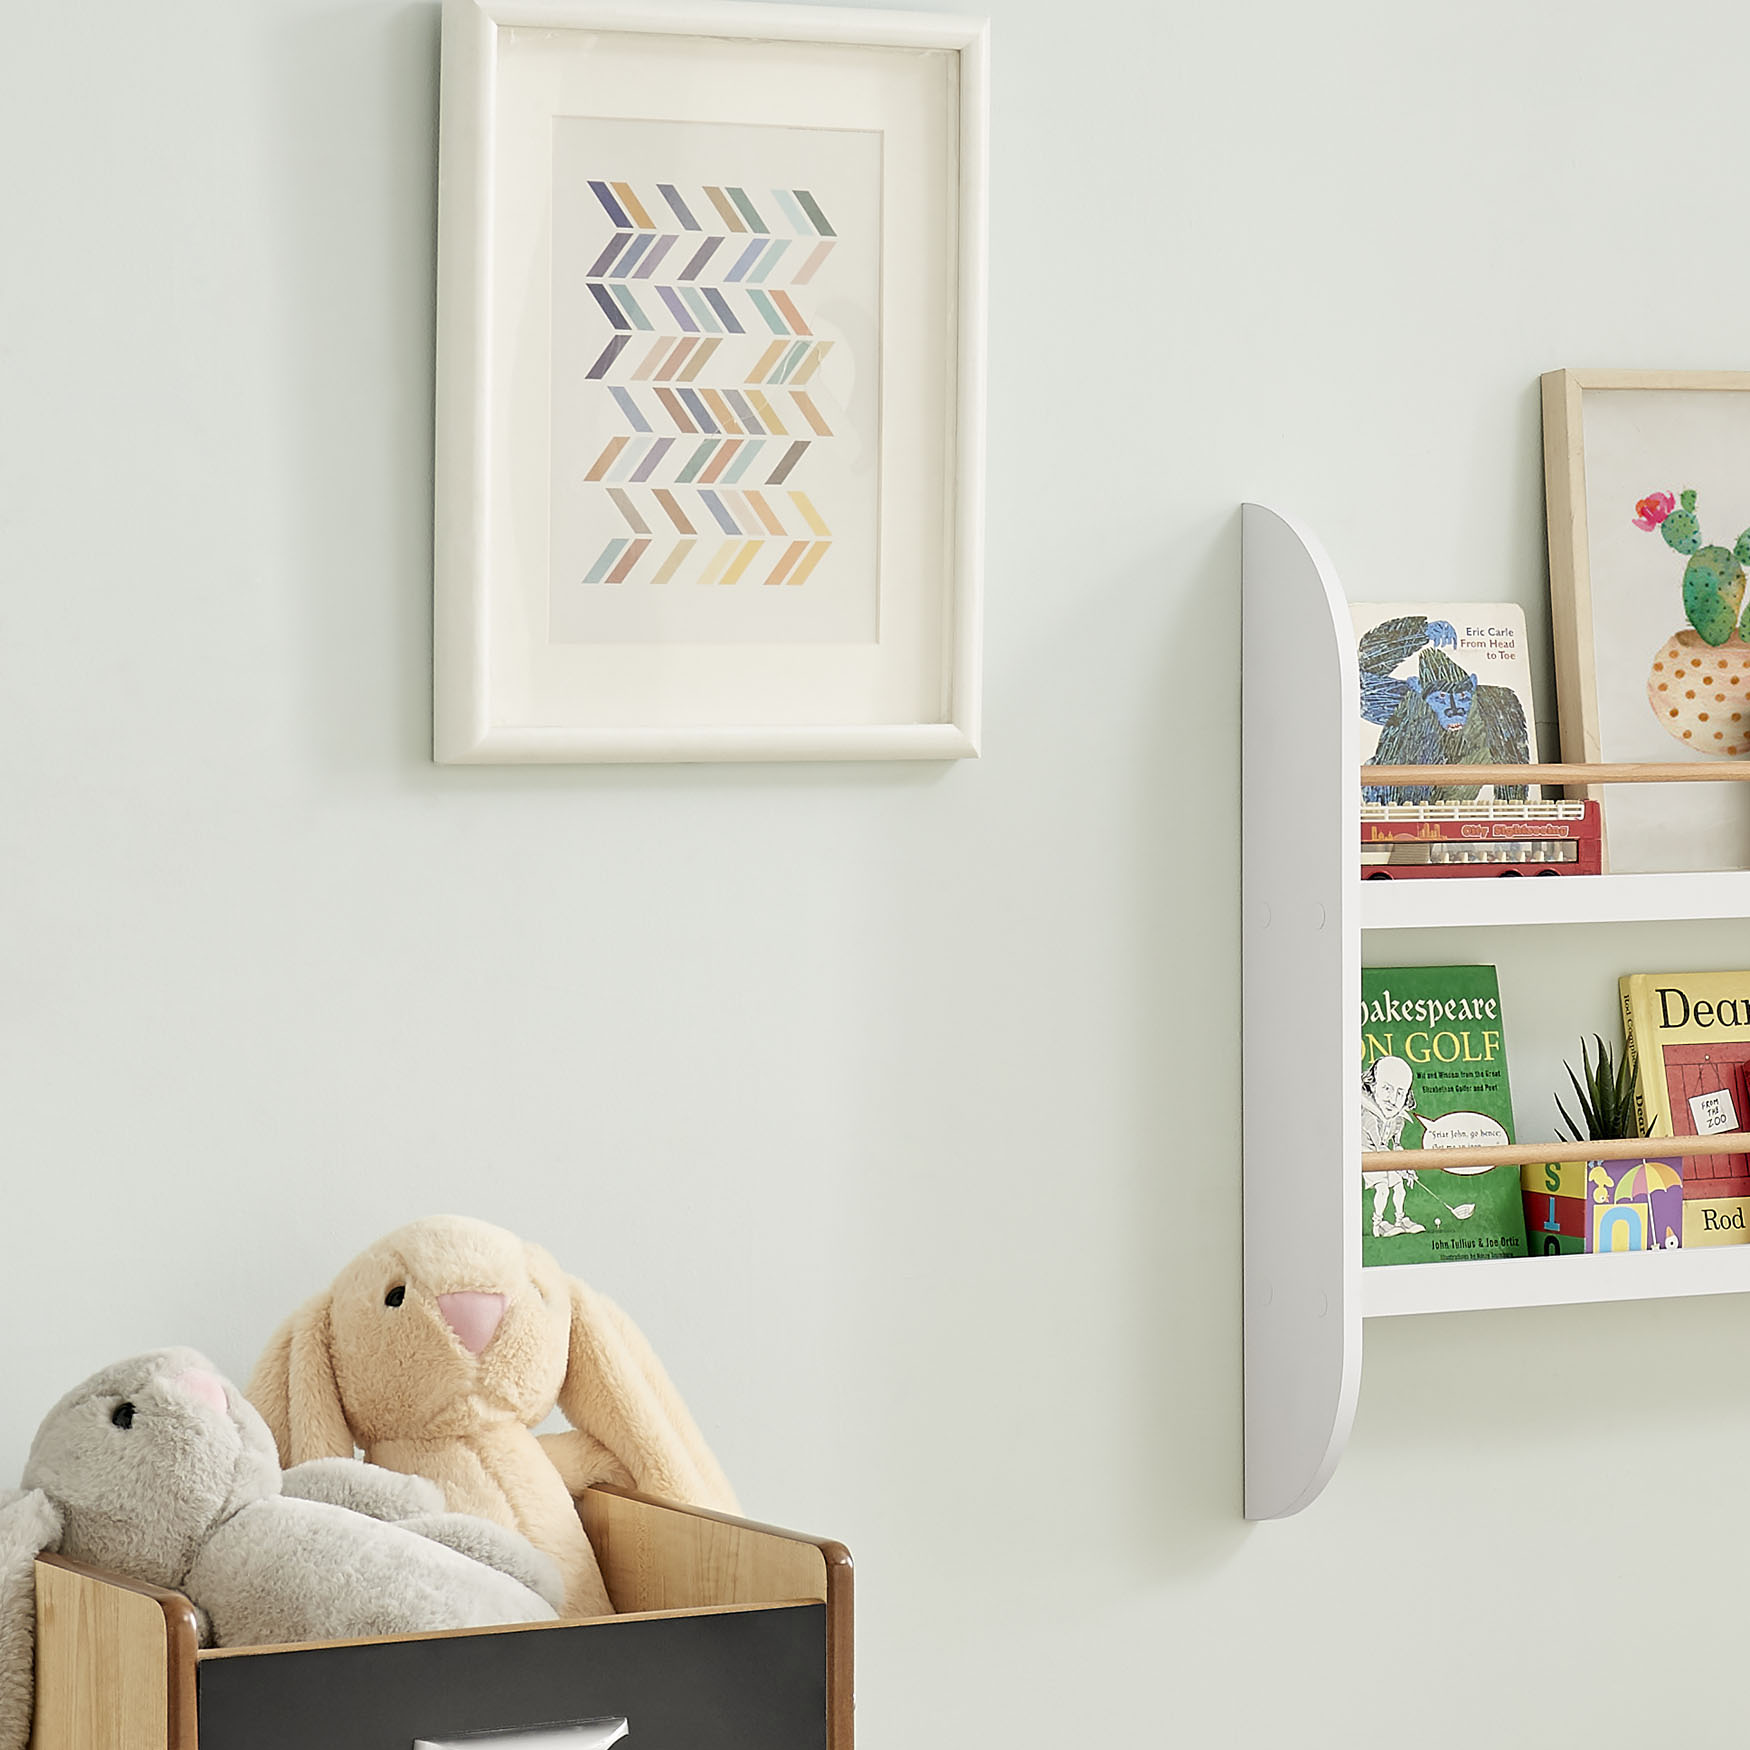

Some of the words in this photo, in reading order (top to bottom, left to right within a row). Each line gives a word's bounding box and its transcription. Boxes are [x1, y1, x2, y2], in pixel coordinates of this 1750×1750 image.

[1466, 627, 1485, 636] Eric
[1488, 627, 1514, 637] Carle
[1460, 639, 1487, 648] From
[1489, 639, 1515, 649] Head
[1487, 652, 1497, 660] to
[1498, 650, 1516, 660] Toe
[1361, 989, 1497, 1029] akespeare
[1361, 1033, 1394, 1065] N
[1405, 1031, 1500, 1063] GOLF
[1701, 1098, 1719, 1110] FROM
[1706, 1114, 1727, 1128] ZOO
[1701, 1207, 1746, 1231] Rod
[1432, 1239, 1450, 1250] John
[1478, 1238, 1484, 1248] &
[1486, 1237, 1498, 1248] Joe
[1500, 1236, 1520, 1248] Ortiz
